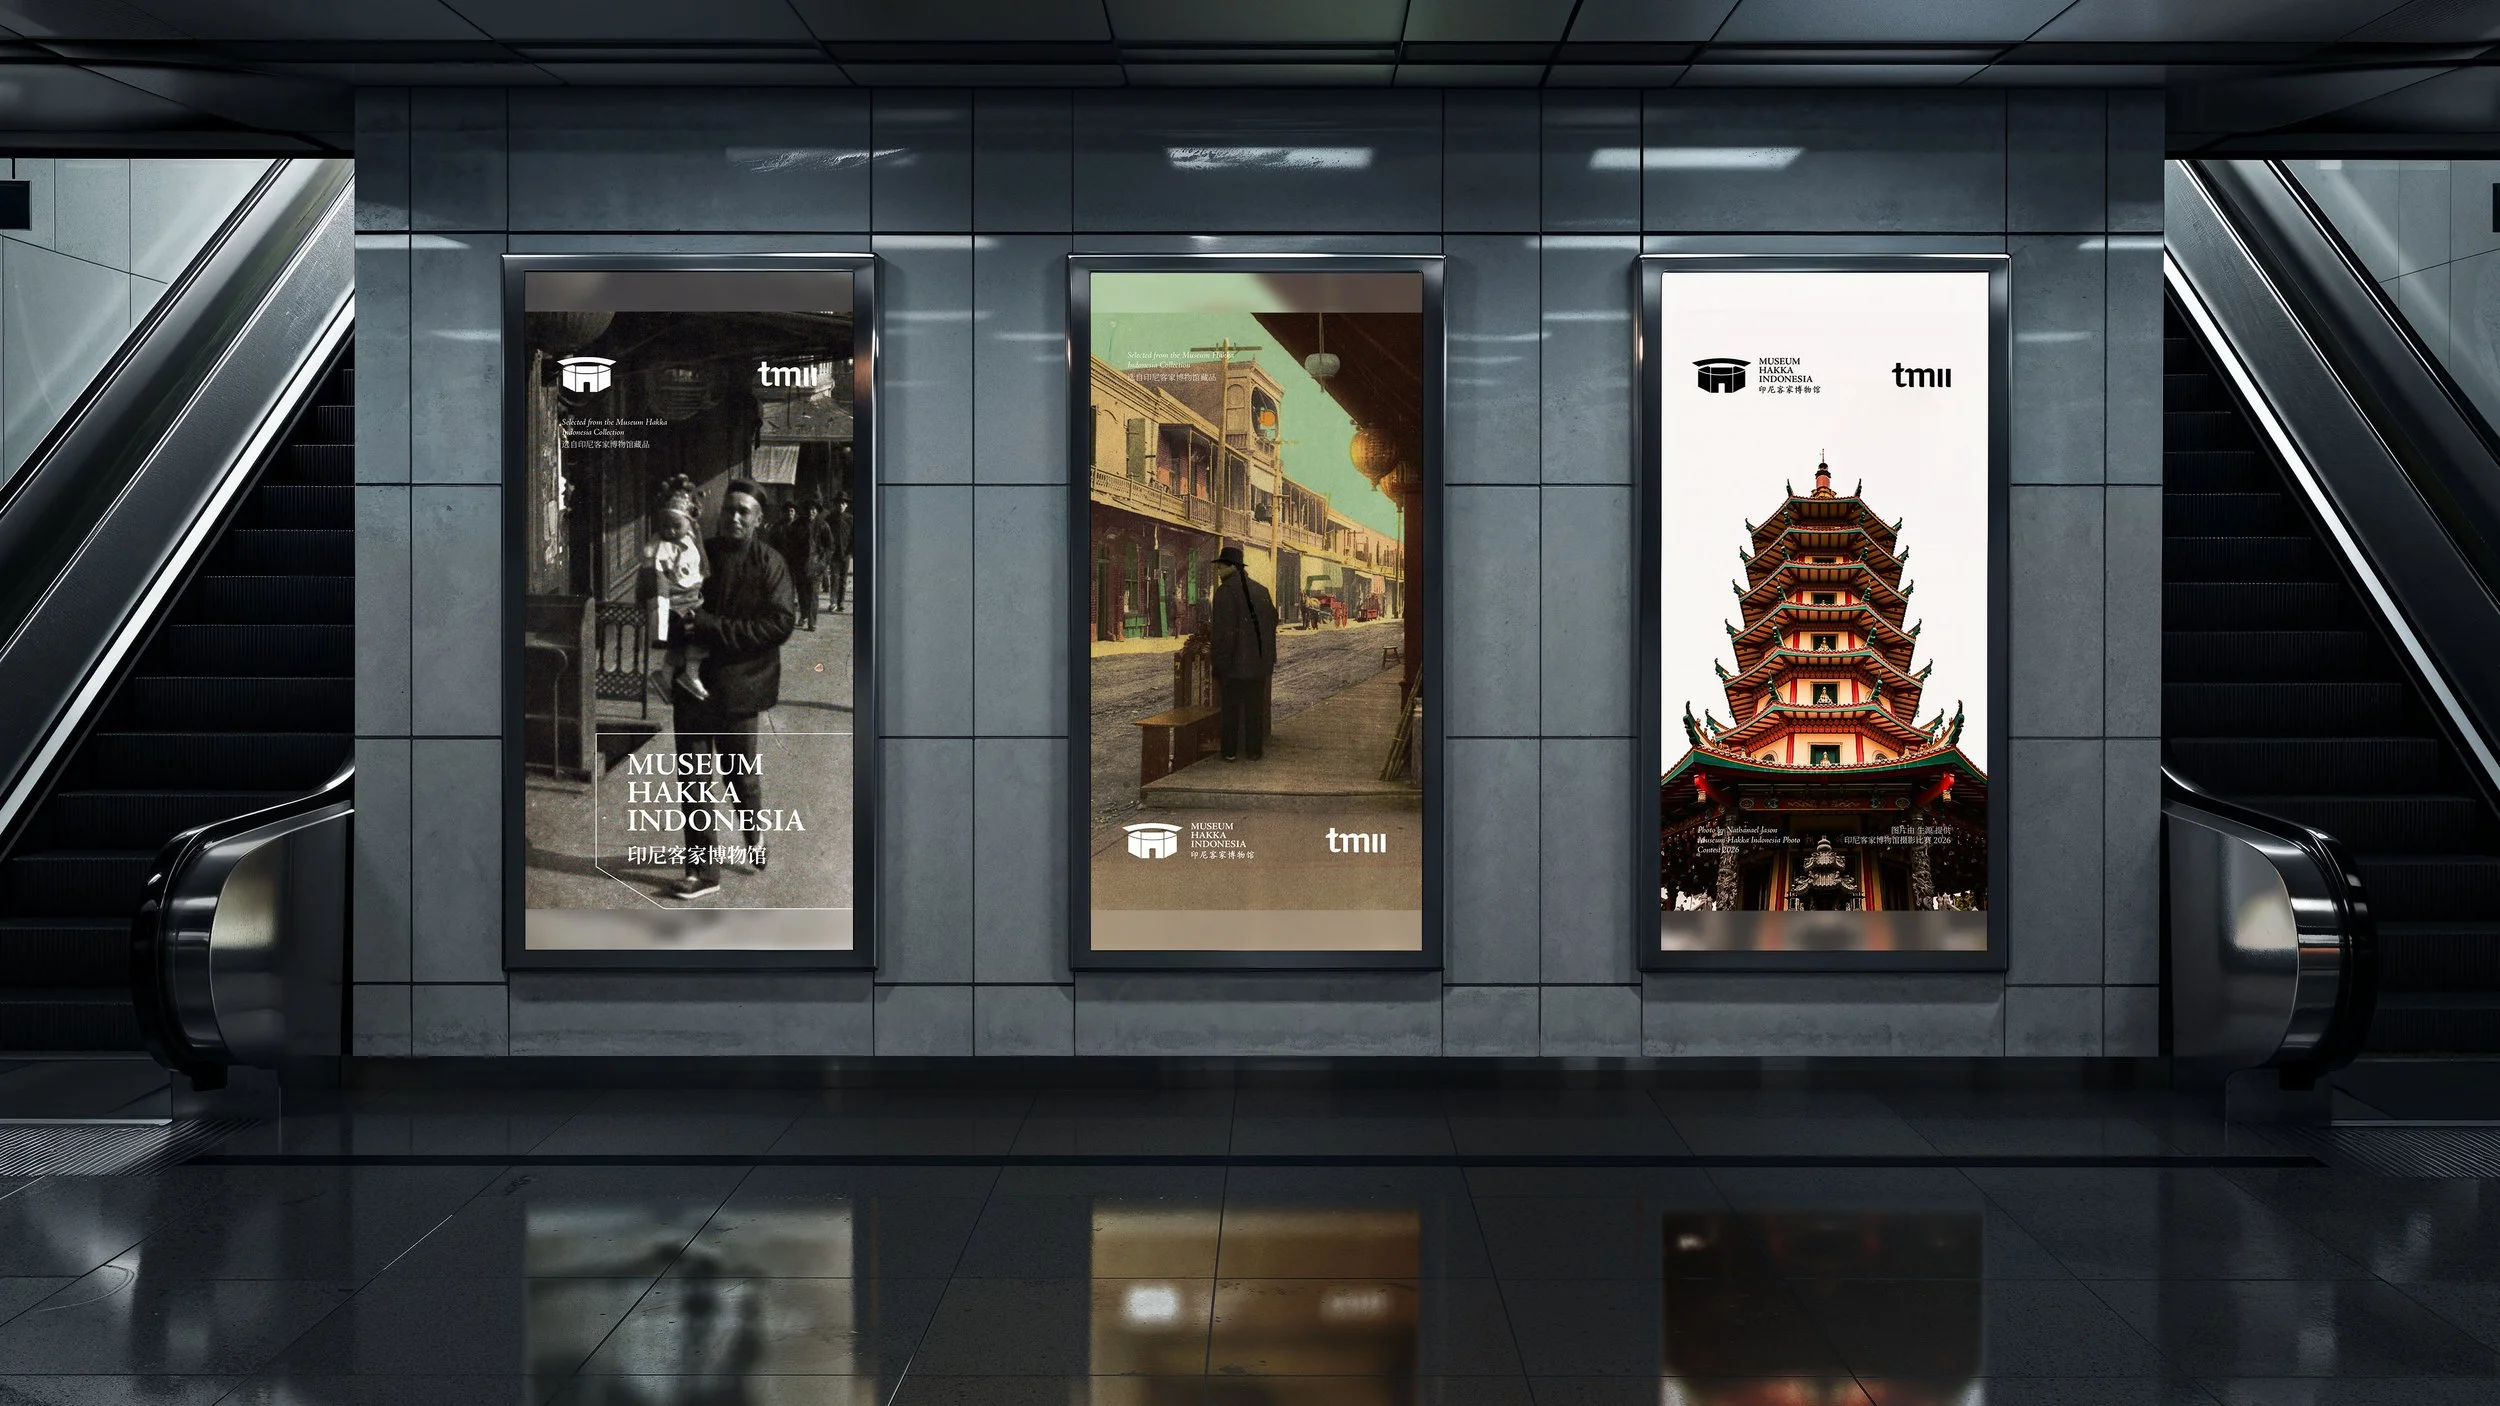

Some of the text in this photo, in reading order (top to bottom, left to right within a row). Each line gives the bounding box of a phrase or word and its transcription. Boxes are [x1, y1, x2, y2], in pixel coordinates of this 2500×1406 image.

[1127, 351, 1152, 359] Selected
[1152, 351, 1169, 361] from
[1170, 351, 1180, 359] the
[1182, 351, 1210, 359] Museum
[1160, 361, 1191, 369] Collection
[1759, 357, 1801, 366] MUSEUM
[1759, 366, 1794, 375] HAKKA
[1759, 375, 1813, 383] INDONESIA
[1758, 385, 1821, 394] 印尼客家博物馆
[561, 418, 668, 428] Selected from the Museum Hakka
[593, 428, 625, 436] Collection
[627, 753, 764, 776] MUSEUM
[627, 781, 742, 804] HAKKA
[627, 809, 806, 832] INDONESIA
[1190, 822, 1234, 831] MUSEUM
[1697, 825, 1778, 836] Photo by Nathanael Jason
[1190, 831, 1227, 839] HAKKA
[1190, 840, 1247, 848] INDONESIA
[1697, 836, 1725, 844] Museum
[1727, 836, 1750, 844] Hakka
[1750, 836, 1781, 844] Indonesia
[1782, 836, 1801, 844] Photo
[1933, 836, 1952, 844] 2026
[1721, 846, 1740, 854] 2026
[627, 846, 767, 866] 印尼客家博物馆
[1190, 850, 1254, 860] 印尼客家博物馆
